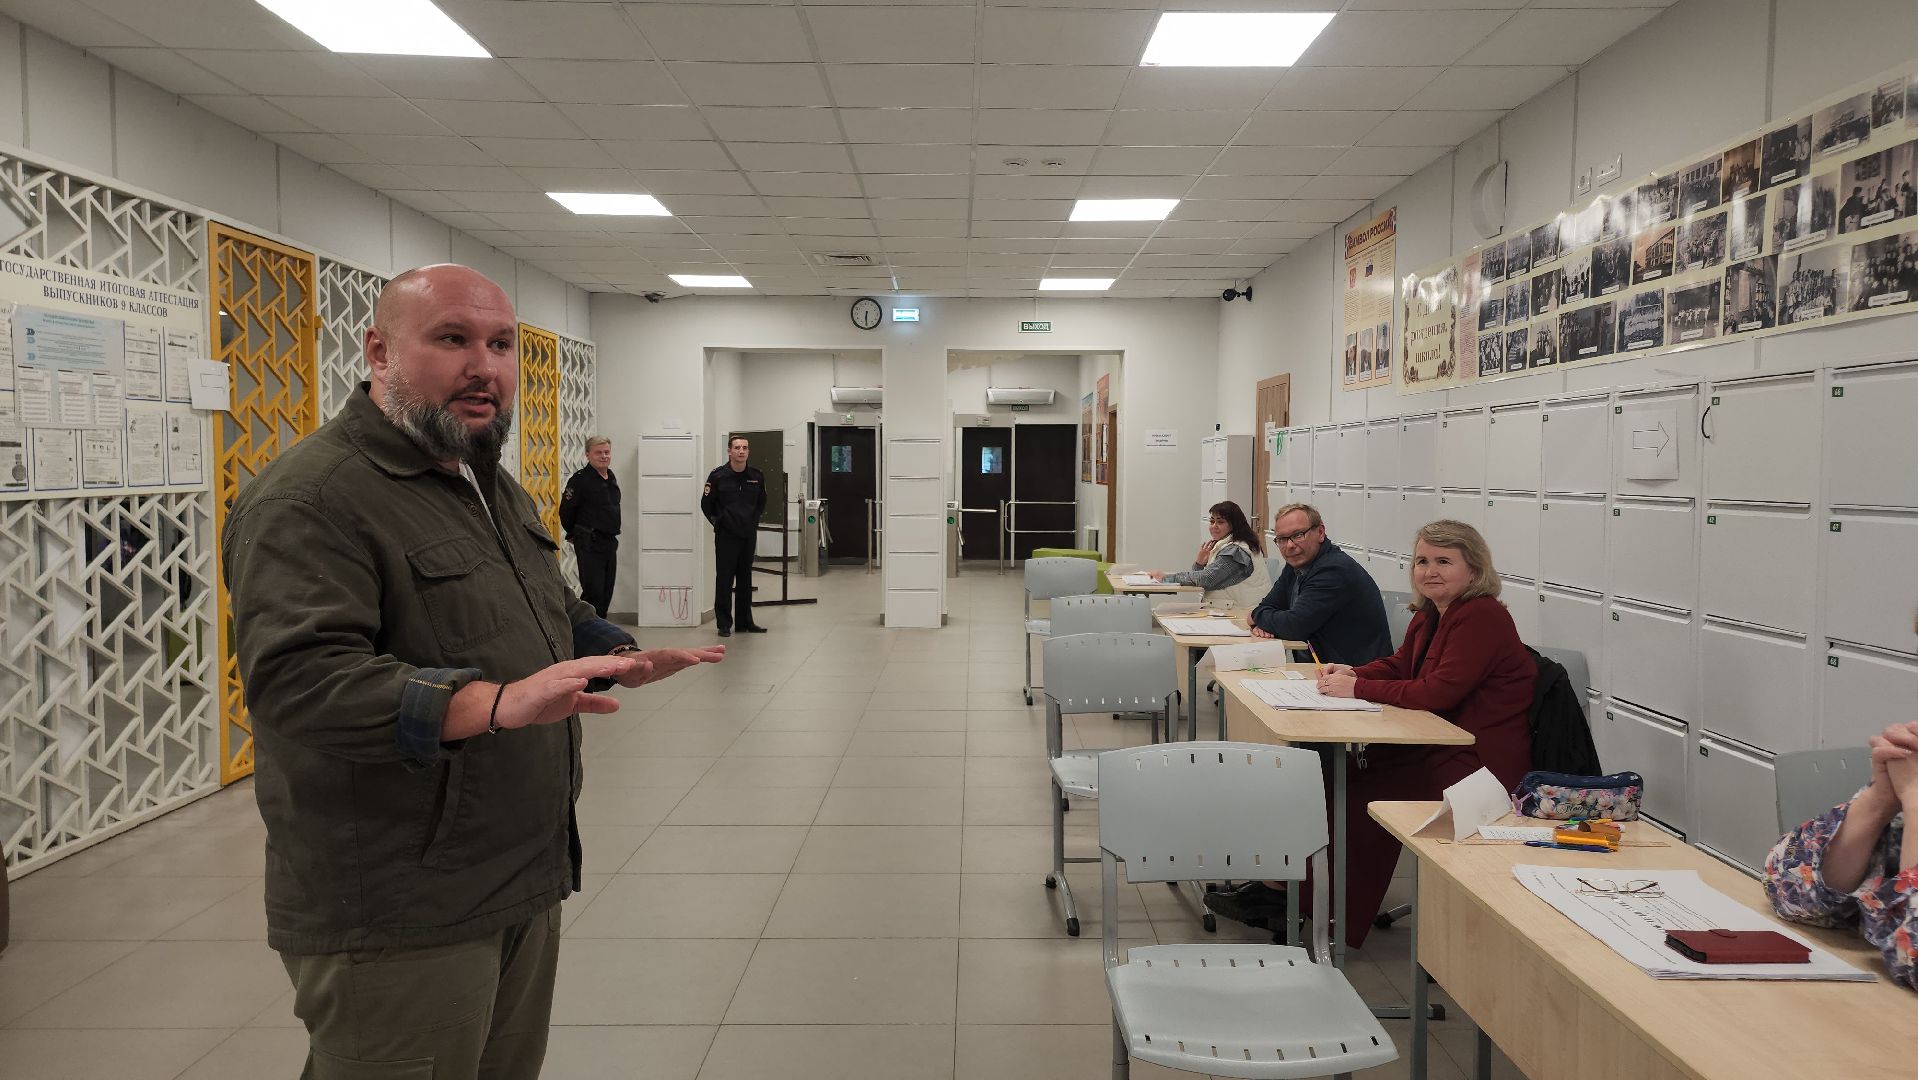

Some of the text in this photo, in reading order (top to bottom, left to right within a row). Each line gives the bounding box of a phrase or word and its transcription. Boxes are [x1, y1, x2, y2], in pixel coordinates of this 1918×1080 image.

[0, 260, 199, 309] ГОСУДАРСТВЕННАЯ ИТОГОВАЯ АТТЕСТАЦИЯ
[43, 285, 168, 318] ВЫПУСКНИКОВ 9 КЛАССОВ
[1023, 322, 1050, 331] ВЫХОД
